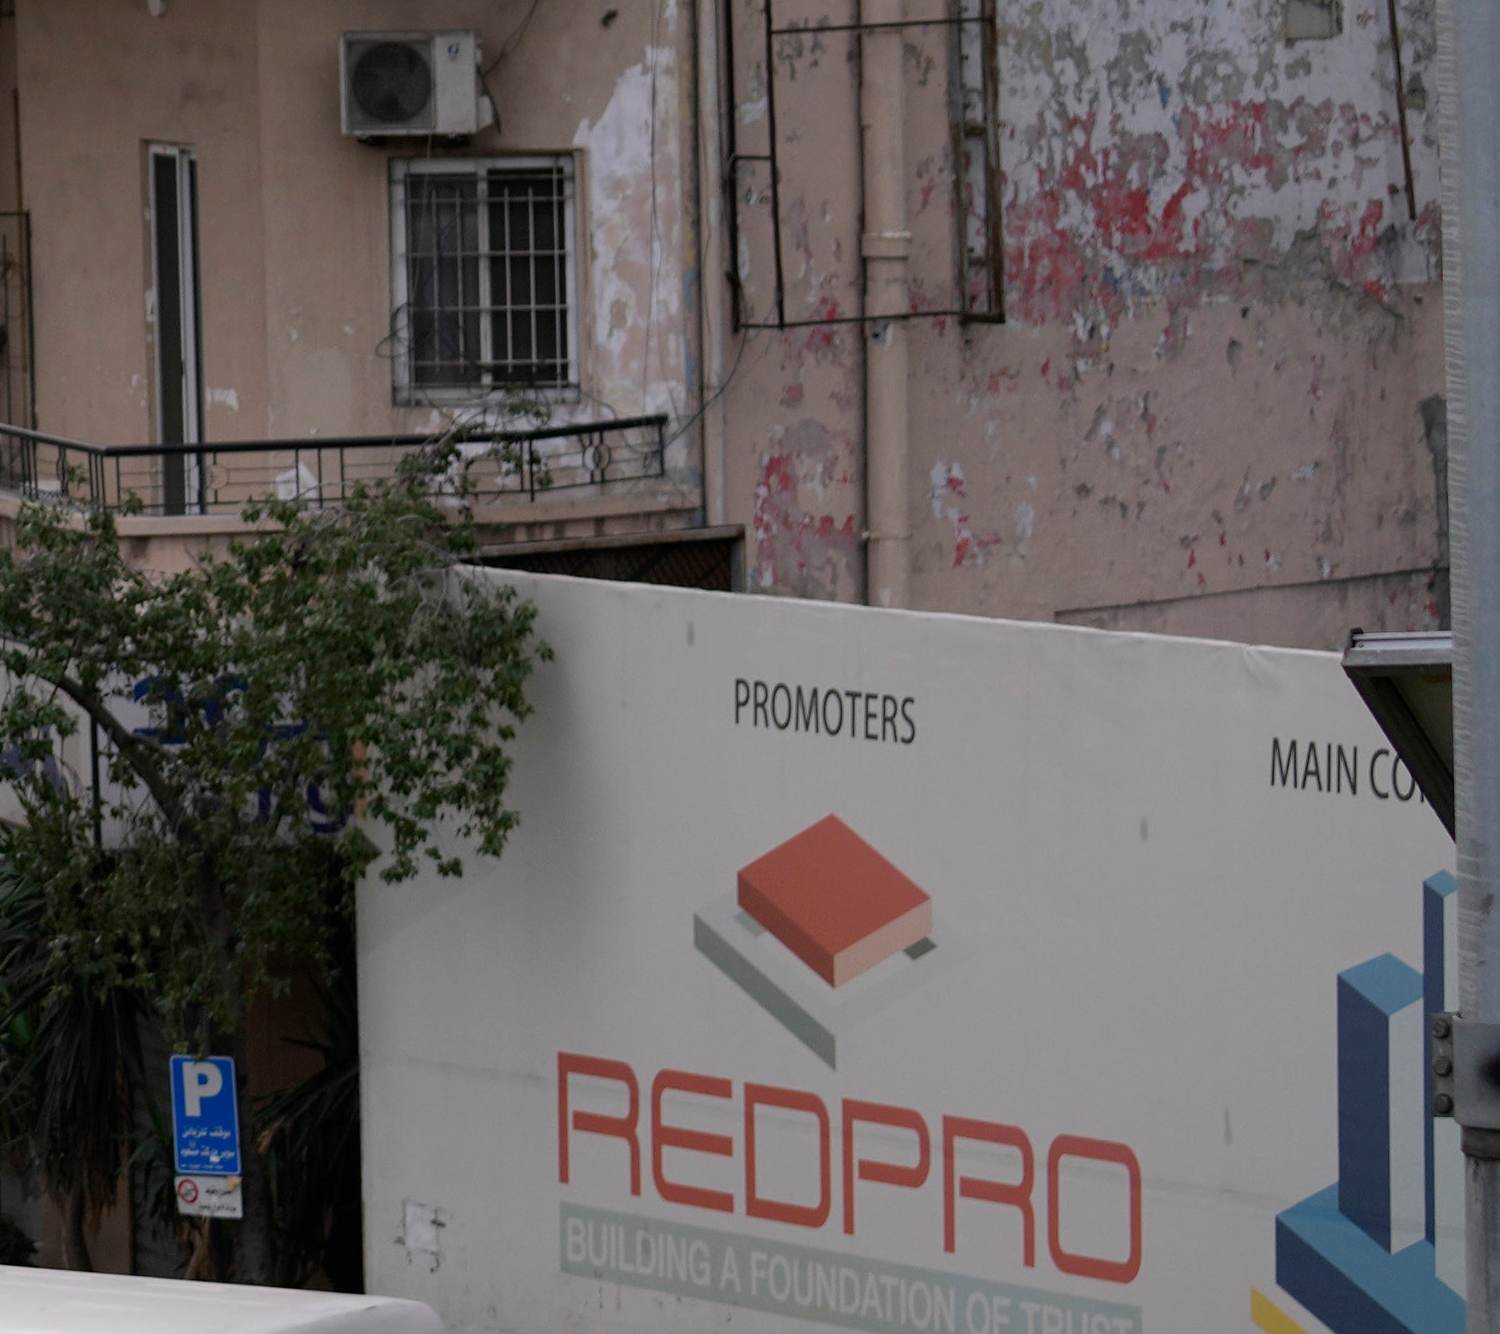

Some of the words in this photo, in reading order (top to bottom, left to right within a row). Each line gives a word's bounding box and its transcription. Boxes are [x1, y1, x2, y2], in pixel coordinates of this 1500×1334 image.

[733, 678, 917, 745] PROMOTERS
[1270, 736, 1358, 796] MAIN
[1369, 747, 1425, 803] CO
[182, 1060, 223, 1118] P
[556, 1050, 1143, 1285] REDPRO
[565, 1217, 713, 1287] BUILDING
[717, 1249, 742, 1295] A
[750, 1251, 957, 1334] FOUNDATION
